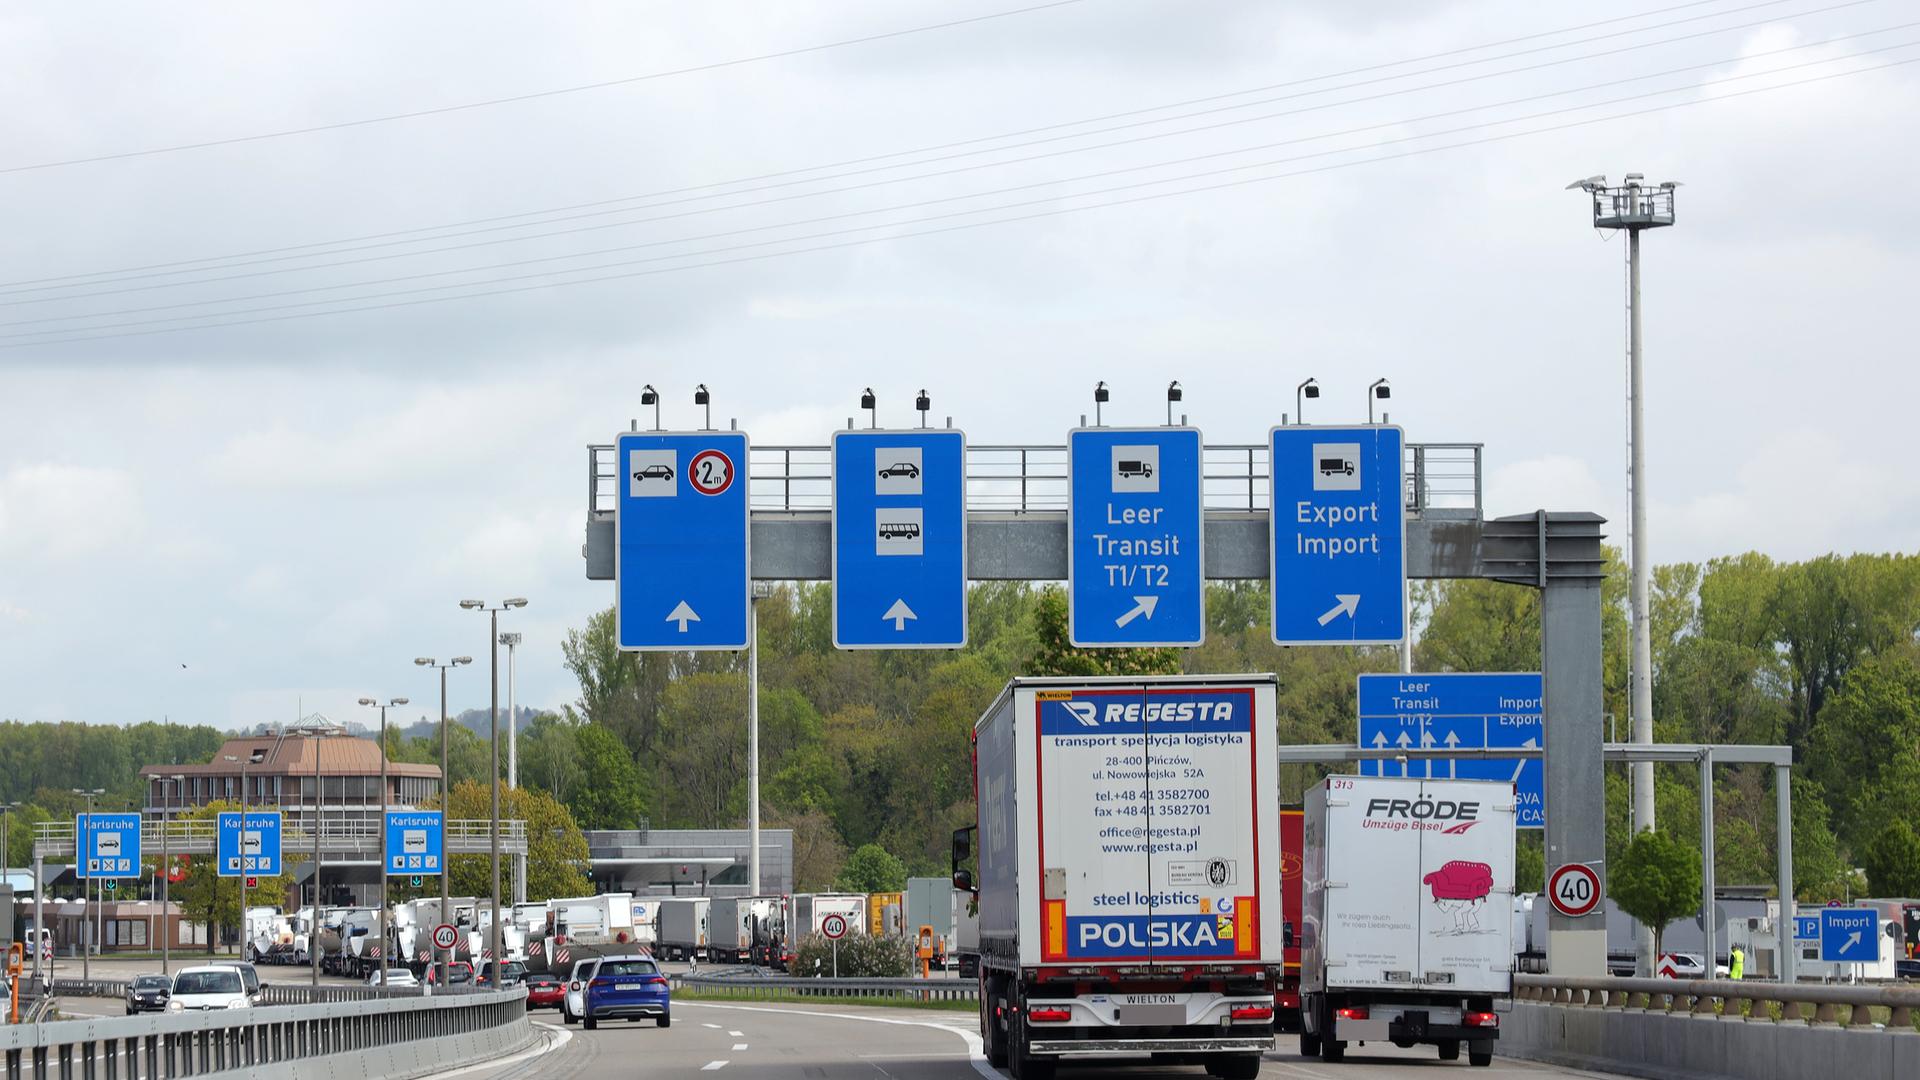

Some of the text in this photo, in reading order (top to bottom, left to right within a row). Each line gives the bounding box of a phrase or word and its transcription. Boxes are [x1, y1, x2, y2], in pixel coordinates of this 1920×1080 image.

[1107, 503, 1164, 525] Leer
[1296, 501, 1379, 527] Export
[1093, 534, 1179, 556] Transit
[1297, 533, 1379, 559] Import
[1400, 680, 1430, 692] Leer
[1392, 697, 1439, 709] Transit
[1104, 702, 1233, 723] REGESTA
[1055, 733, 1244, 748] transport spedycja logistyka
[1105, 756, 1142, 766] 28-400
[1092, 771, 1104, 780] ul.
[1183, 768, 1205, 778] 52A
[1334, 780, 1354, 790] 313
[1139, 790, 1154, 800] 41
[1157, 789, 1210, 800] 3582700
[1094, 804, 1211, 817] fax +48 41 3582701
[1366, 793, 1480, 820] FRÖDE
[225, 818, 275, 828] Karsruhe
[391, 816, 439, 826] Karlsruhe
[1362, 819, 1444, 831] Umzüge Basel
[1099, 826, 1201, 838] office@regesta.pl
[1102, 841, 1198, 854] www.regesta.pl
[1561, 878, 1590, 901] 40
[1093, 891, 1200, 907] steel logistics
[827, 920, 842, 933] 40
[1807, 922, 1816, 934] P
[1829, 915, 1870, 930] Import
[438, 930, 453, 943] 40
[1080, 921, 1218, 948] POLSKA
[1126, 994, 1176, 1004] WIELTON
